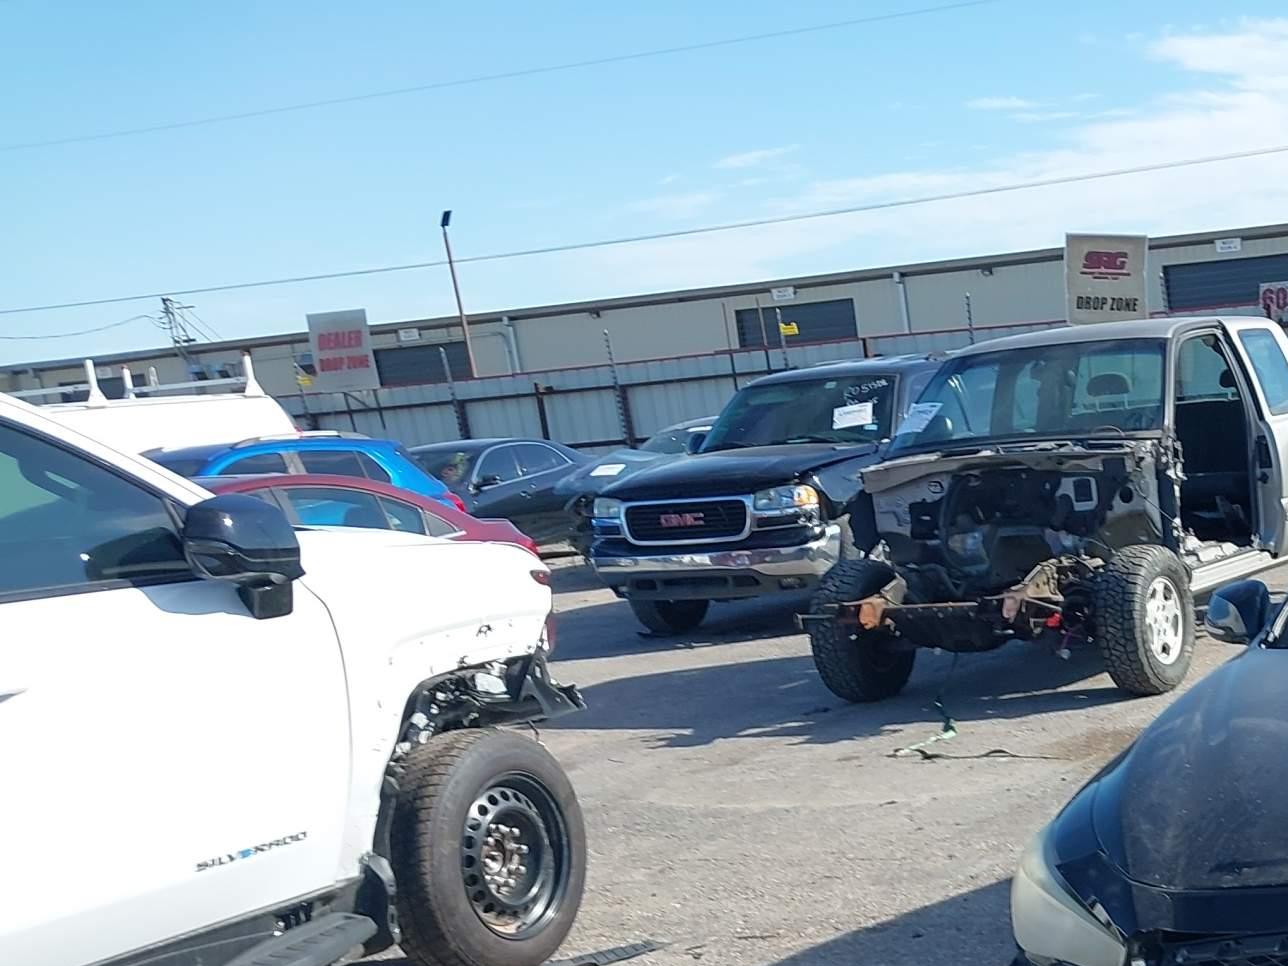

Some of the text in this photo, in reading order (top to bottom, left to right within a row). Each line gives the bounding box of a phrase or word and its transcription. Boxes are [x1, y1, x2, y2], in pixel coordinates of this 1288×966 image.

[1075, 295, 1139, 312] DROP ZONE
[1262, 287, 1288, 311] 60
[318, 329, 363, 351] DEALER
[319, 354, 370, 372] DROP ZONE
[660, 512, 705, 528] GMC
